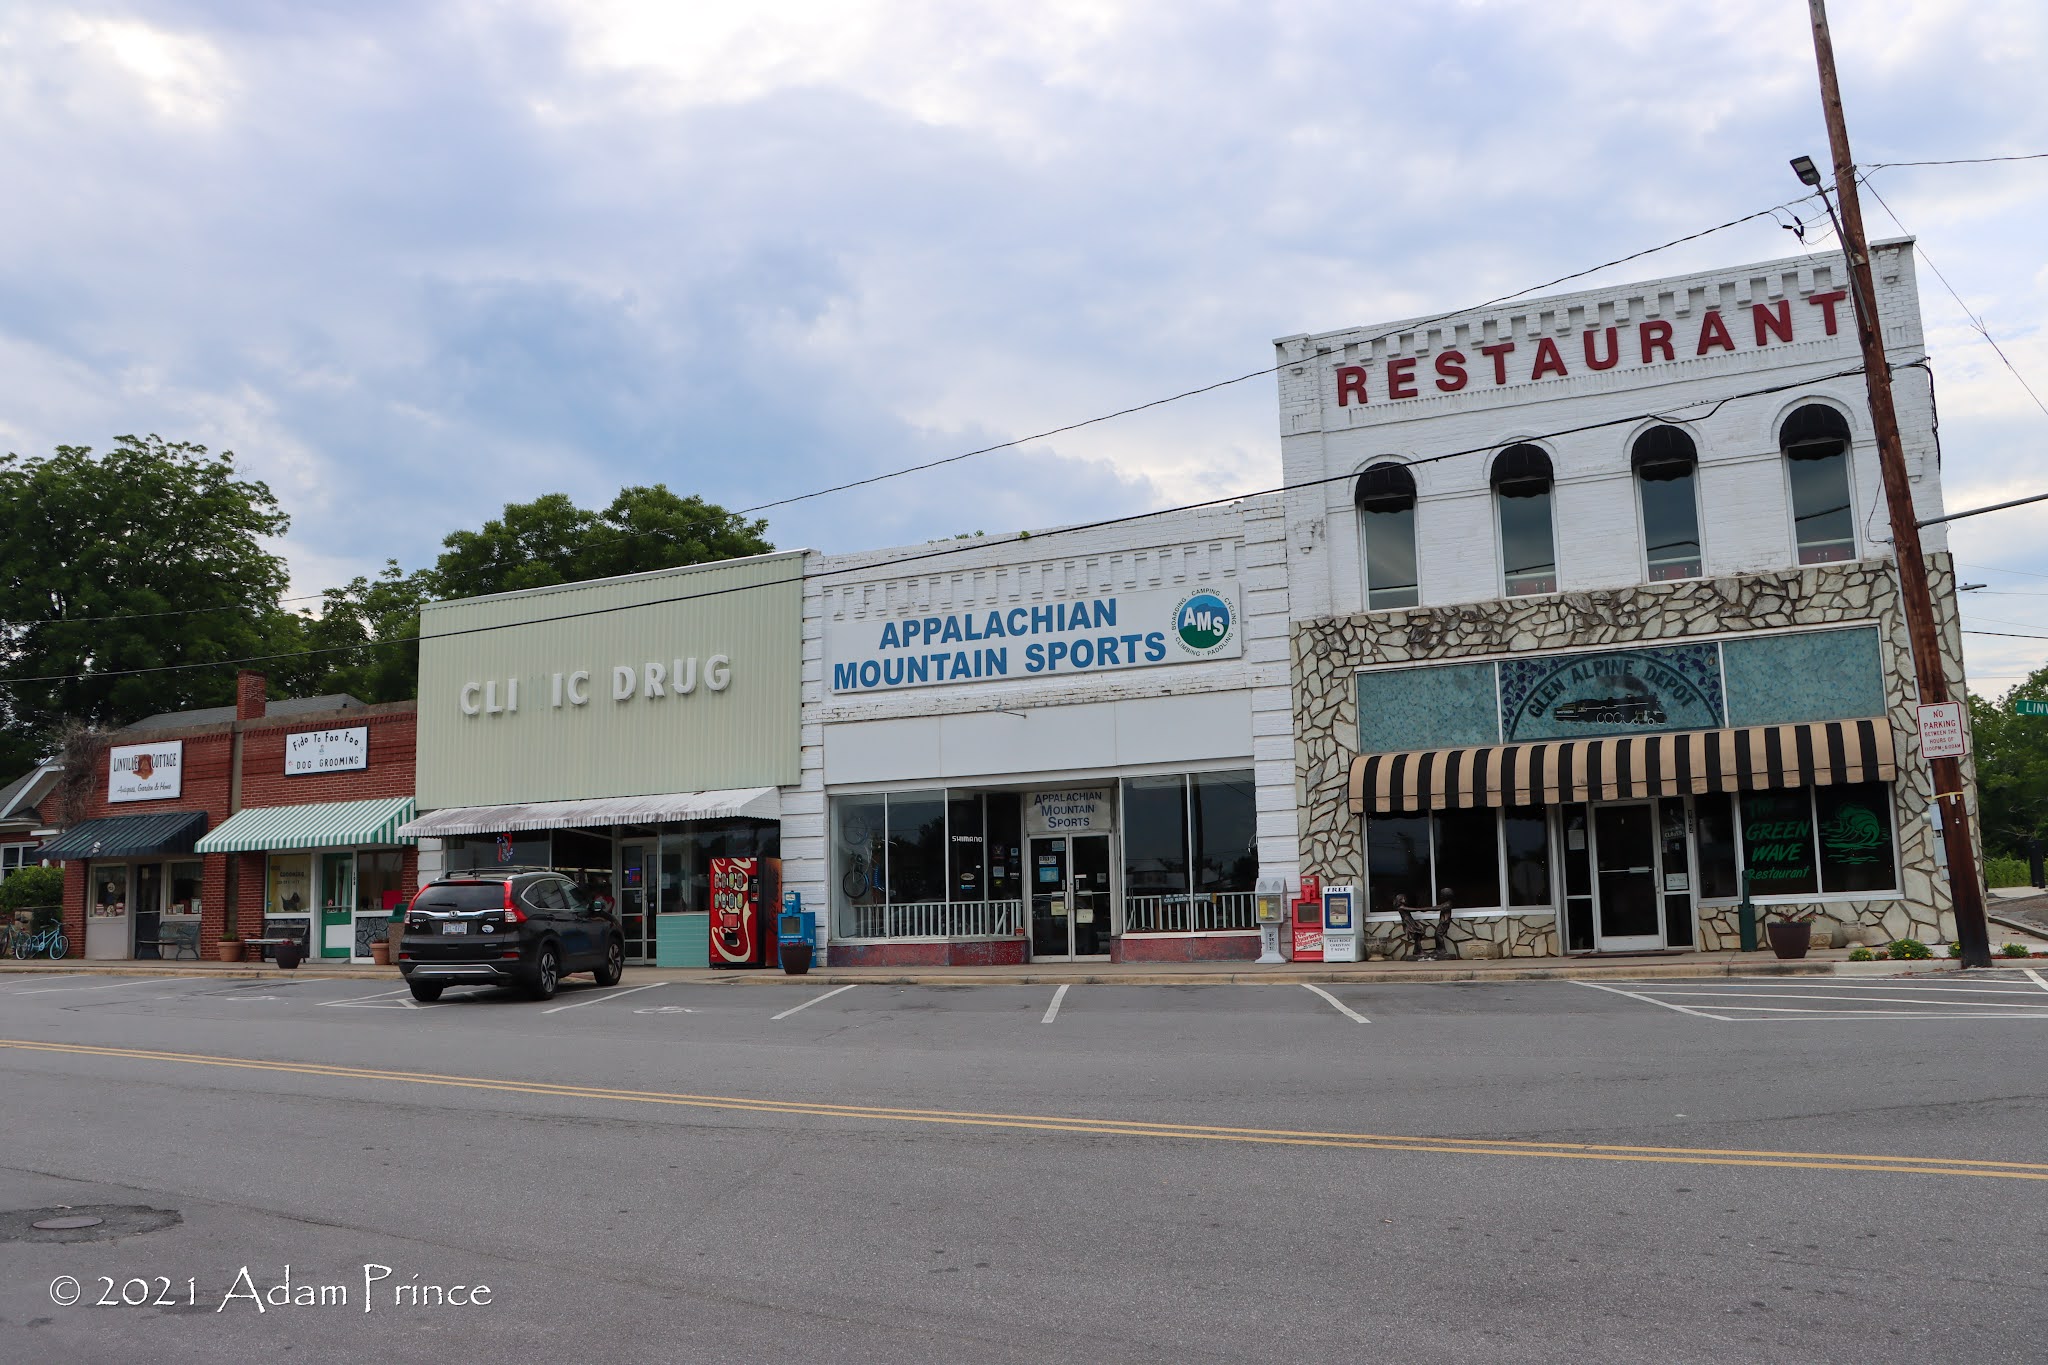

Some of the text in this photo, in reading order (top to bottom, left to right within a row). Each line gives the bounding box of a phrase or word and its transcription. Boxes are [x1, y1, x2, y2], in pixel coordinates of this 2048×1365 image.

[1336, 290, 1846, 407] RESTAURANT
[1191, 588, 1221, 597] CAMPING
[1170, 597, 1187, 631] BOARDING
[1183, 606, 1225, 637] AMS
[1223, 597, 1237, 625] CYCLING
[879, 597, 1118, 650] APPALACHIAN
[1175, 636, 1201, 657] CLIMBING
[1207, 632, 1234, 656] PADDLING
[833, 631, 1167, 690] MOUNTAIN SPORTS
[612, 654, 731, 701] DRUG
[1527, 659, 1698, 719] GLEN ALPINE DEPOT
[1933, 710, 1944, 718] NO
[1923, 720, 1956, 730] PARKING
[292, 731, 359, 751] Fido To Foo Foo
[113, 753, 177, 772] LINVILLE COTTAGE
[296, 756, 359, 770] DOG GROOMING
[951, 835, 983, 843] SHIMANO
[1745, 820, 1811, 841] GREEN
[1751, 843, 1804, 862] WAVE
[1747, 865, 1811, 880] Restaurant
